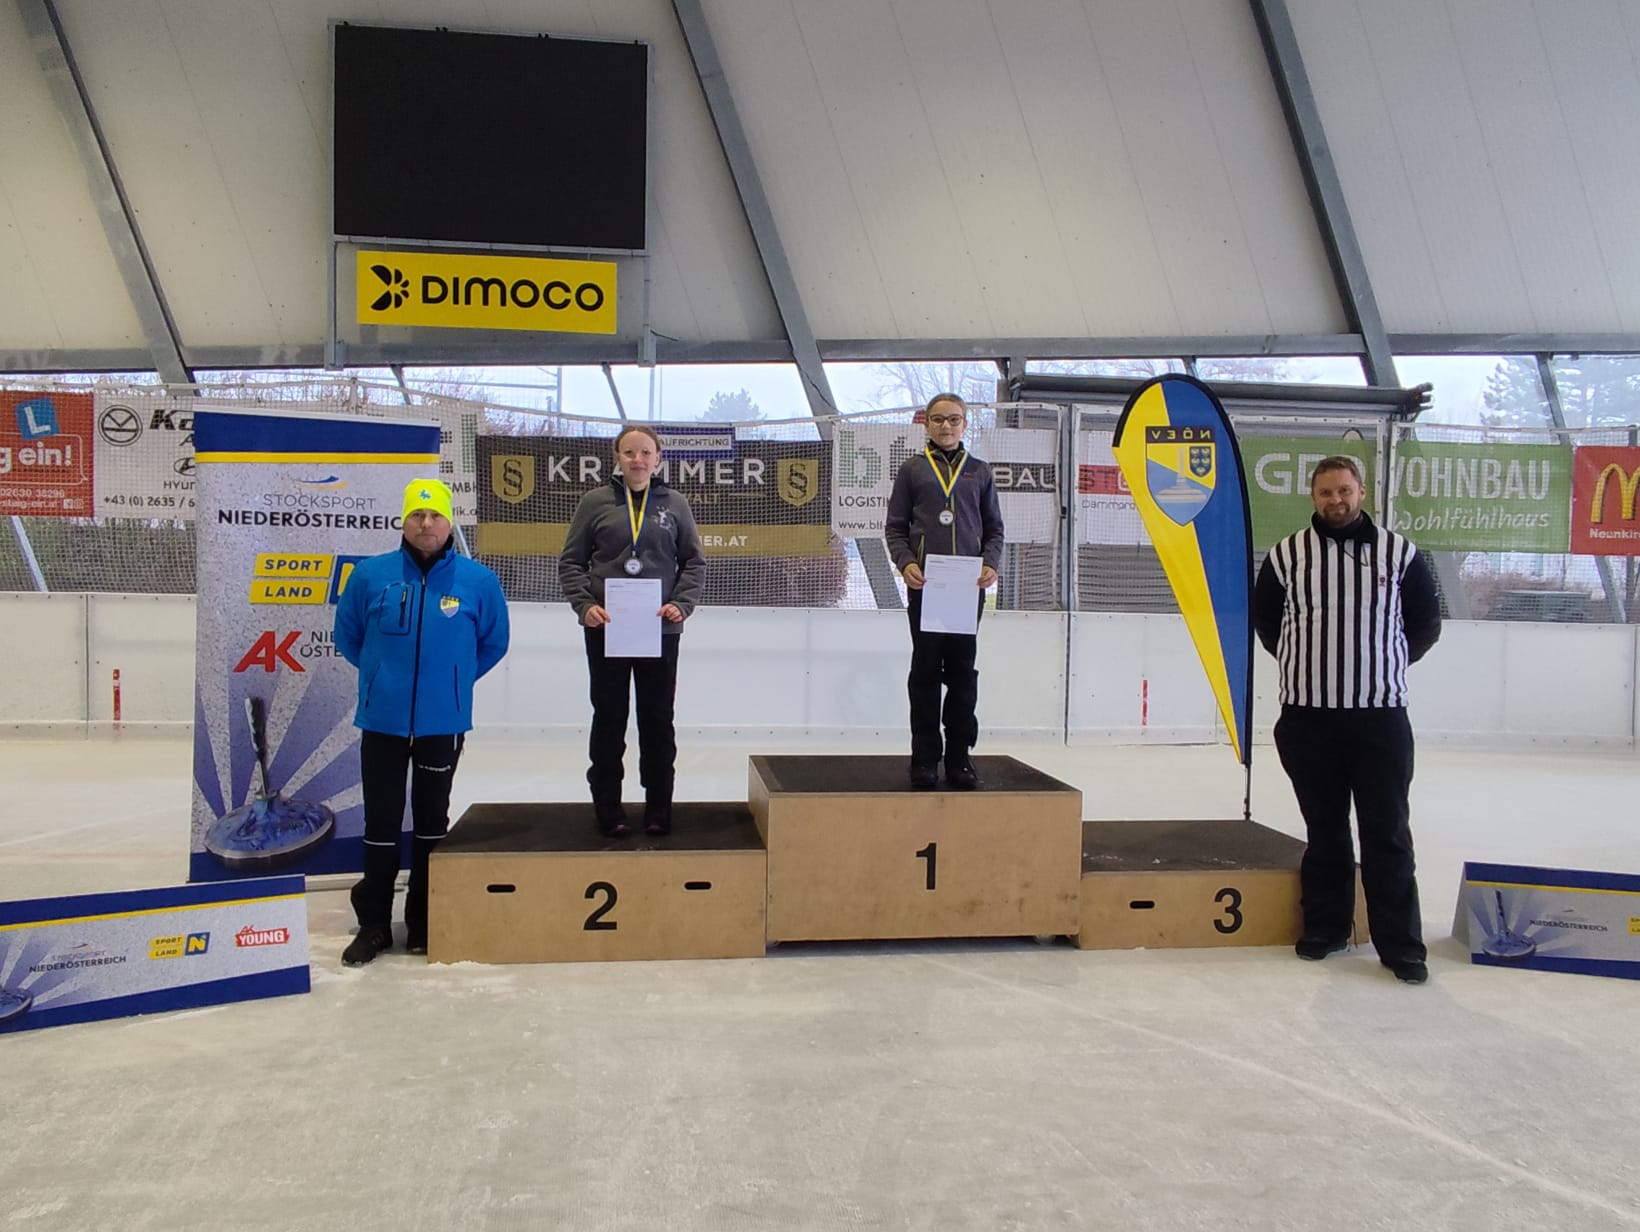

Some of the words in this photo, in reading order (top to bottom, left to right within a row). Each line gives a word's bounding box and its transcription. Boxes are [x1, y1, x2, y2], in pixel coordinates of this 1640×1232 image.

[422, 275, 604, 311] DIMOCO
[25, 406, 51, 434] L
[18, 441, 72, 466] ein!
[548, 455, 765, 485] KRMMER
[104, 495, 126, 506] +43
[128, 496, 144, 507] (0)
[147, 497, 175, 508] 2635
[263, 493, 376, 510] STOCKSPORT
[217, 509, 403, 531] NIEDERÖSTERREIC
[264, 559, 322, 571] SPORT
[264, 586, 312, 598] LAND
[233, 630, 306, 672] AK
[915, 842, 937, 890] 1
[583, 881, 618, 931] 2
[1213, 887, 1243, 934] 3
[239, 930, 285, 946] YOUNG
[28, 955, 127, 973] NIEDERÖSTERREICH
